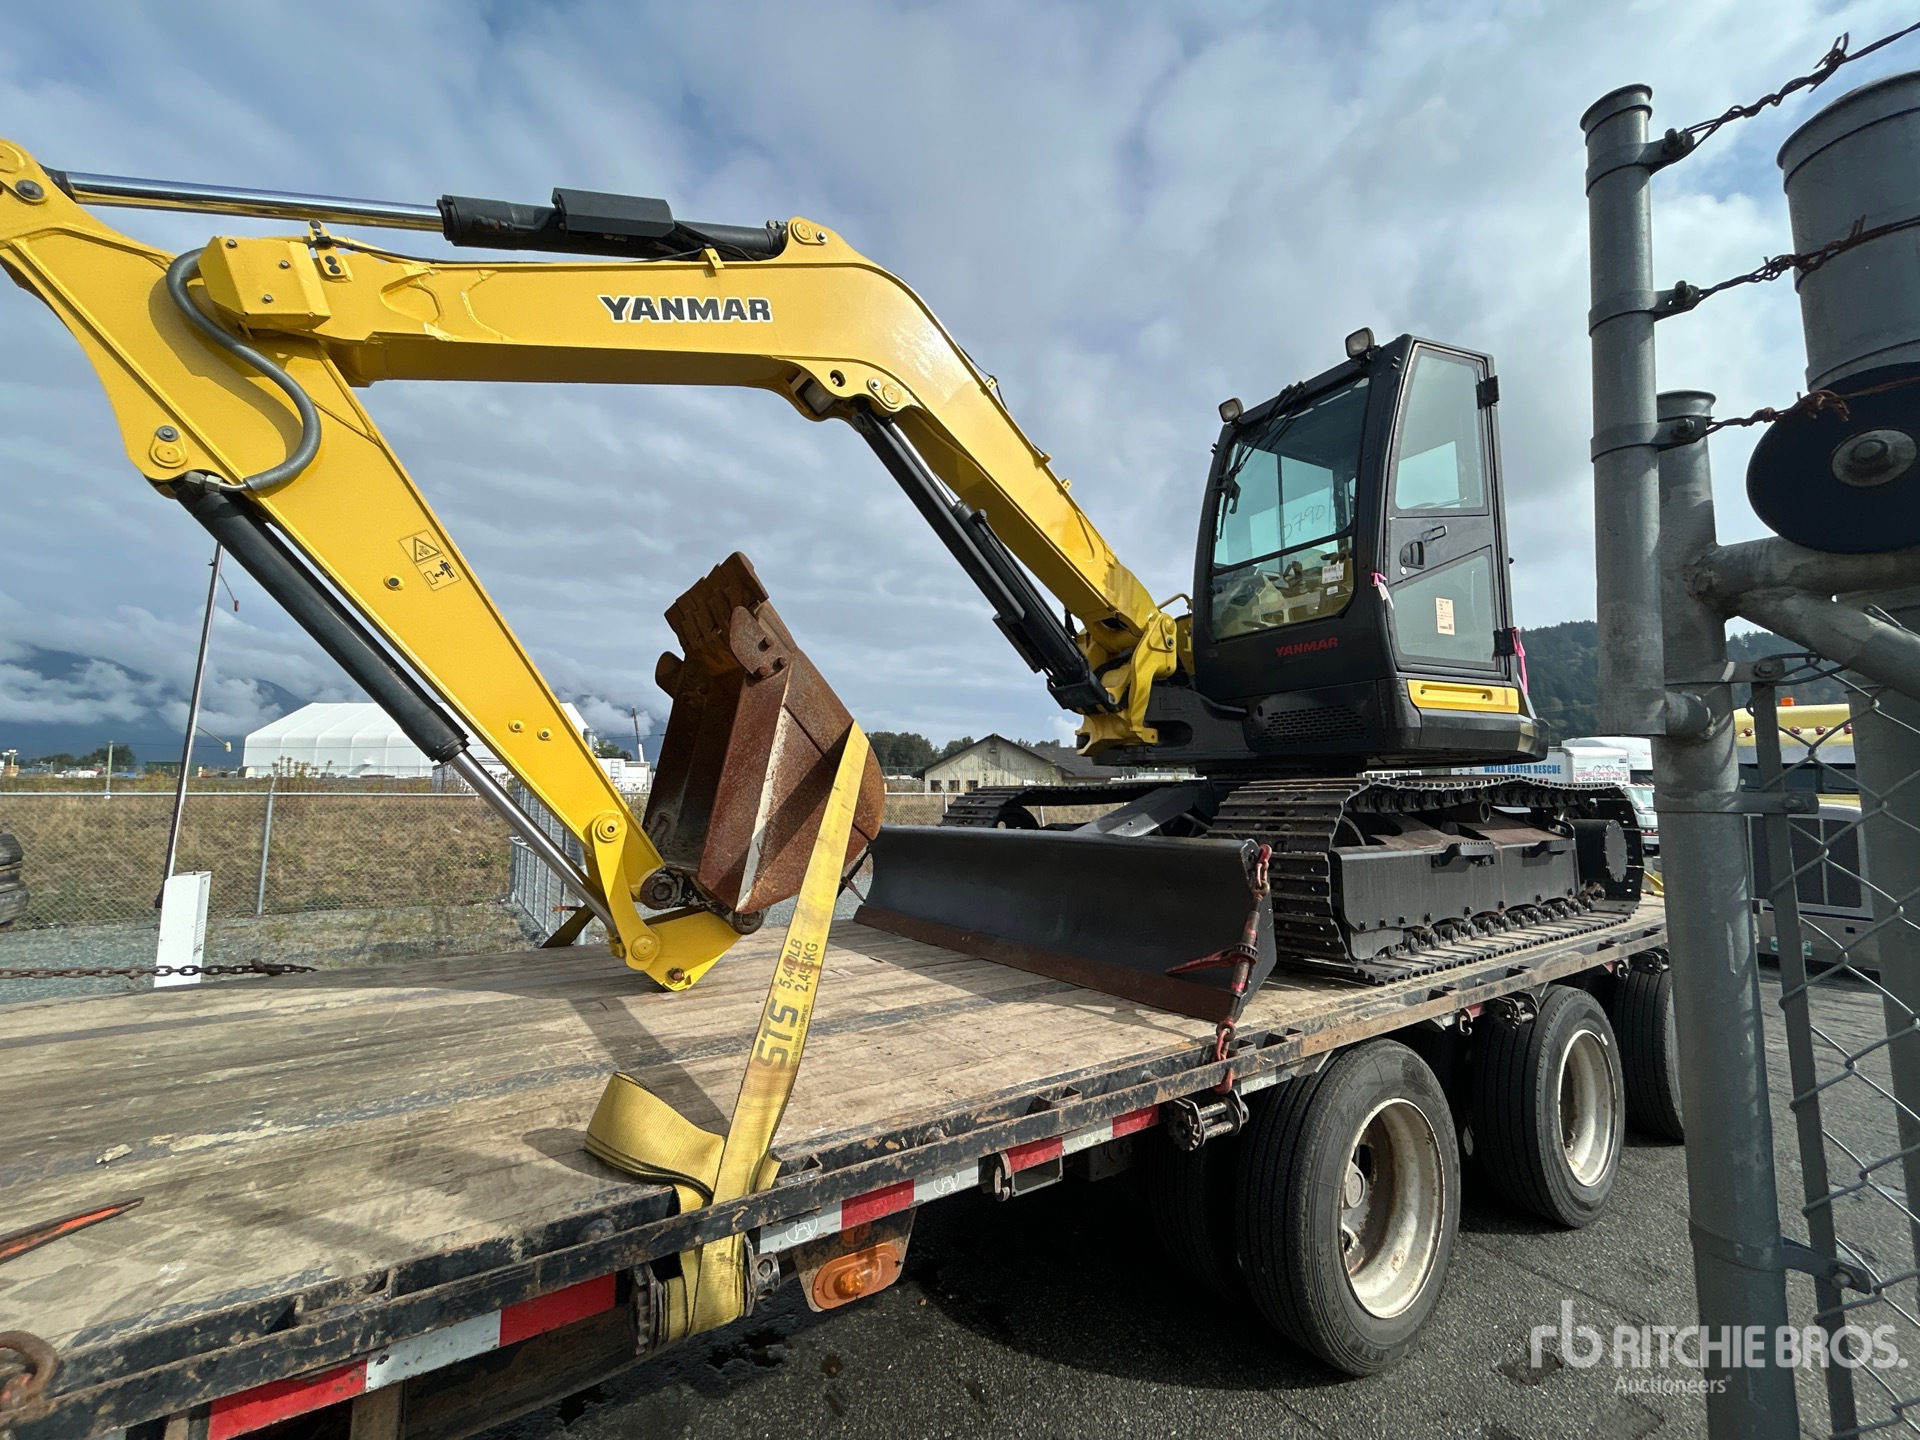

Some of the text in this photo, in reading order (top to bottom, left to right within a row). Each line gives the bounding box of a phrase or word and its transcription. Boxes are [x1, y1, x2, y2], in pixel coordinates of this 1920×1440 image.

[598, 295, 772, 322] YANMAR
[1275, 637, 1339, 657] YANMAR
[1484, 765, 1506, 774] WATER
[1508, 765, 1532, 774] HEATER
[1534, 765, 1562, 775] RESCUE
[795, 943, 819, 992] 2,455KG
[756, 998, 799, 1070] STS
